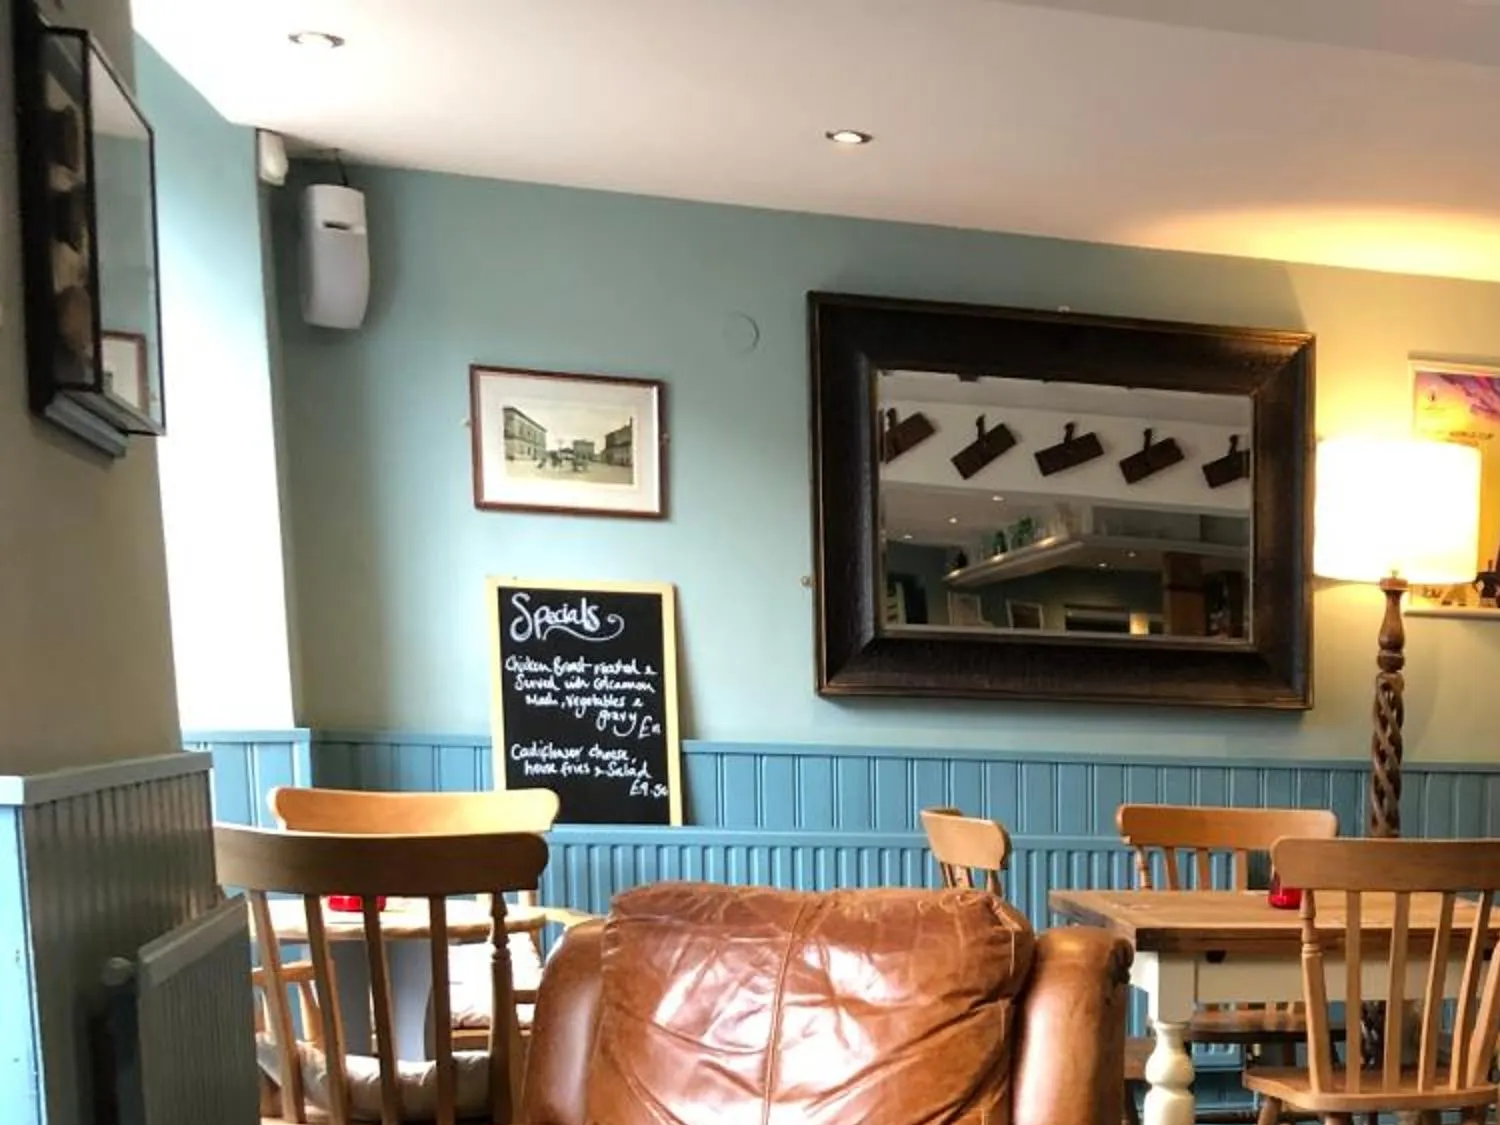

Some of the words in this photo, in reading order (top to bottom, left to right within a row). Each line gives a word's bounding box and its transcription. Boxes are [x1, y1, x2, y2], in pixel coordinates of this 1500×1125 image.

[510, 592, 600, 642] Specials
[563, 675, 590, 689] with
[595, 709, 637, 737] gravy
